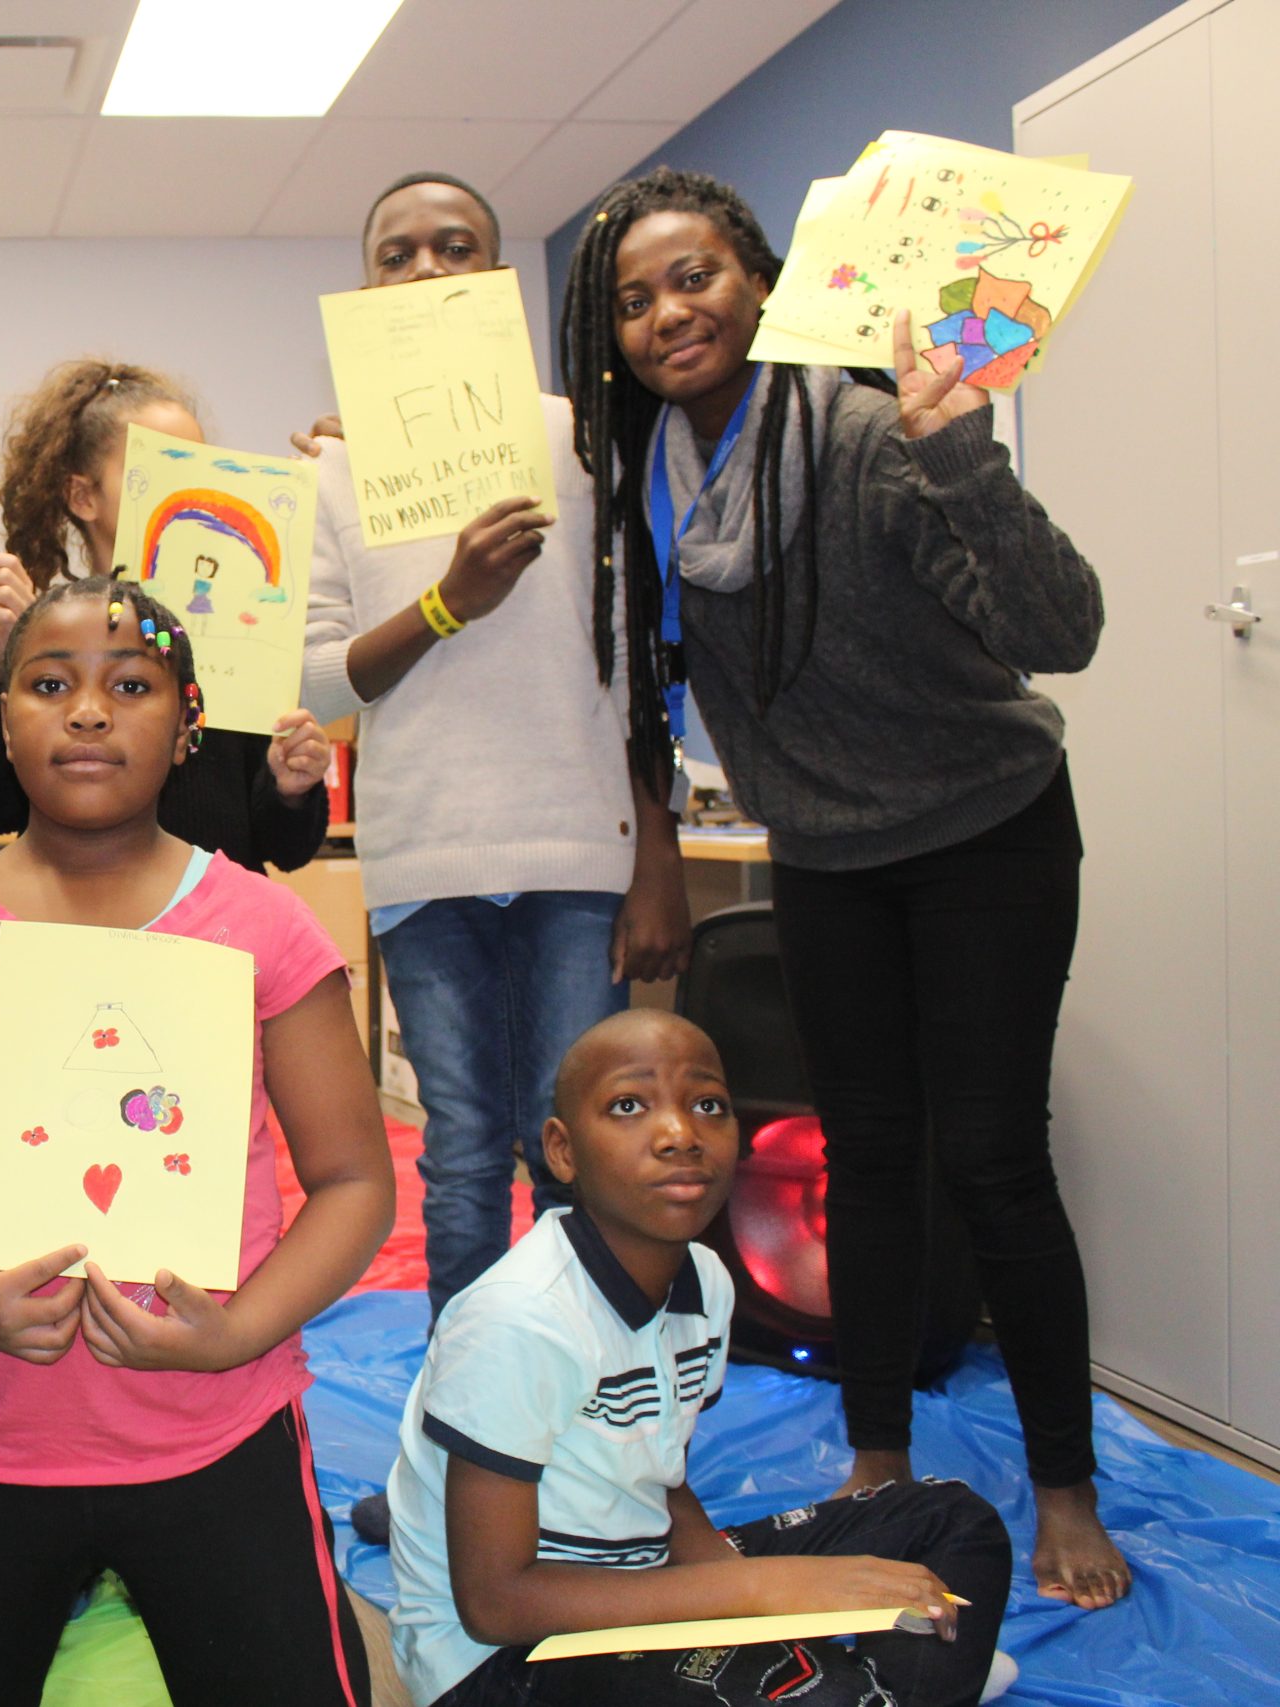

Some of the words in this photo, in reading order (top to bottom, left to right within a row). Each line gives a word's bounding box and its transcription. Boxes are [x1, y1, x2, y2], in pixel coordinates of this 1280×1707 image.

[433, 459, 455, 482] LA
[458, 442, 521, 473] COUPE
[368, 513, 393, 538] DU
[396, 493, 459, 529] MONDE
